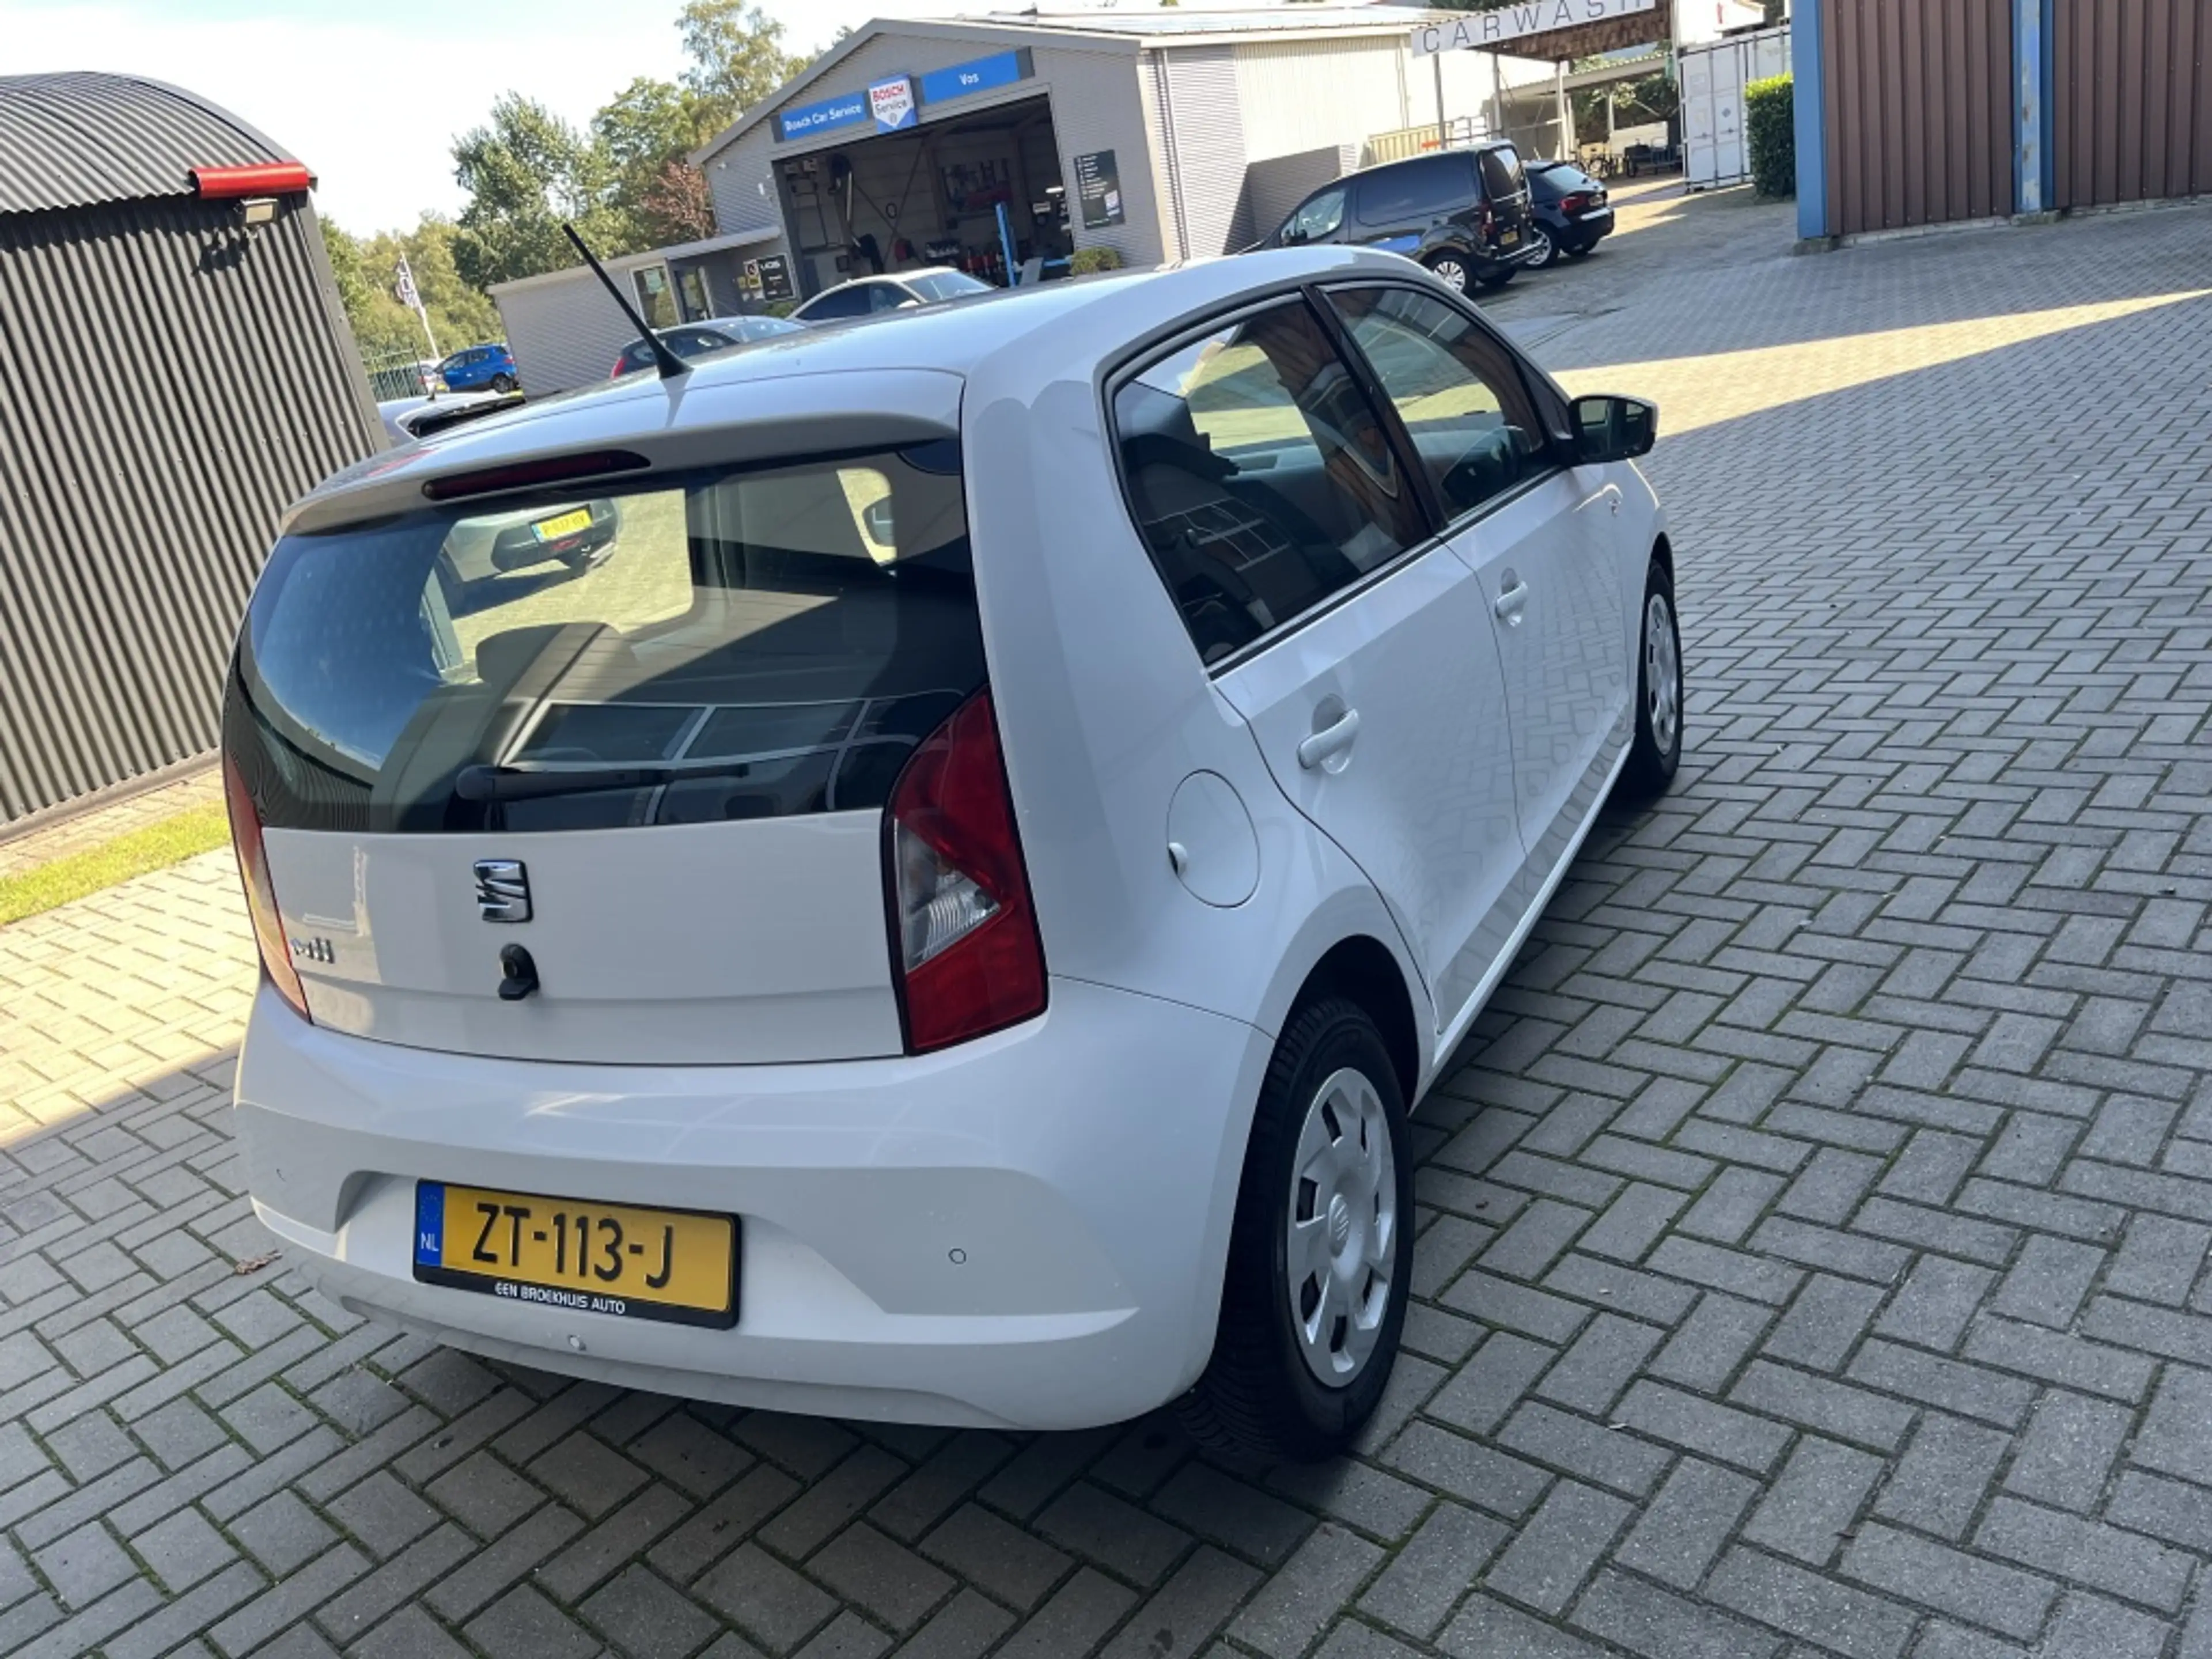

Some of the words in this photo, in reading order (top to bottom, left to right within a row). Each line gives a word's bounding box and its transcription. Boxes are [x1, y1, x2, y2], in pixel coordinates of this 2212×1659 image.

[959, 73, 979, 85] Vos
[872, 84, 905, 101] BOSCH
[874, 99, 908, 115] Service
[784, 118, 812, 132] Bosch
[812, 112, 828, 124] Car
[829, 104, 862, 120] Service
[421, 1232, 440, 1252] NL
[472, 1203, 673, 1289] ZT-113-J
[520, 1285, 588, 1308] BROEKHUIS
[591, 1297, 626, 1315] AUTO
